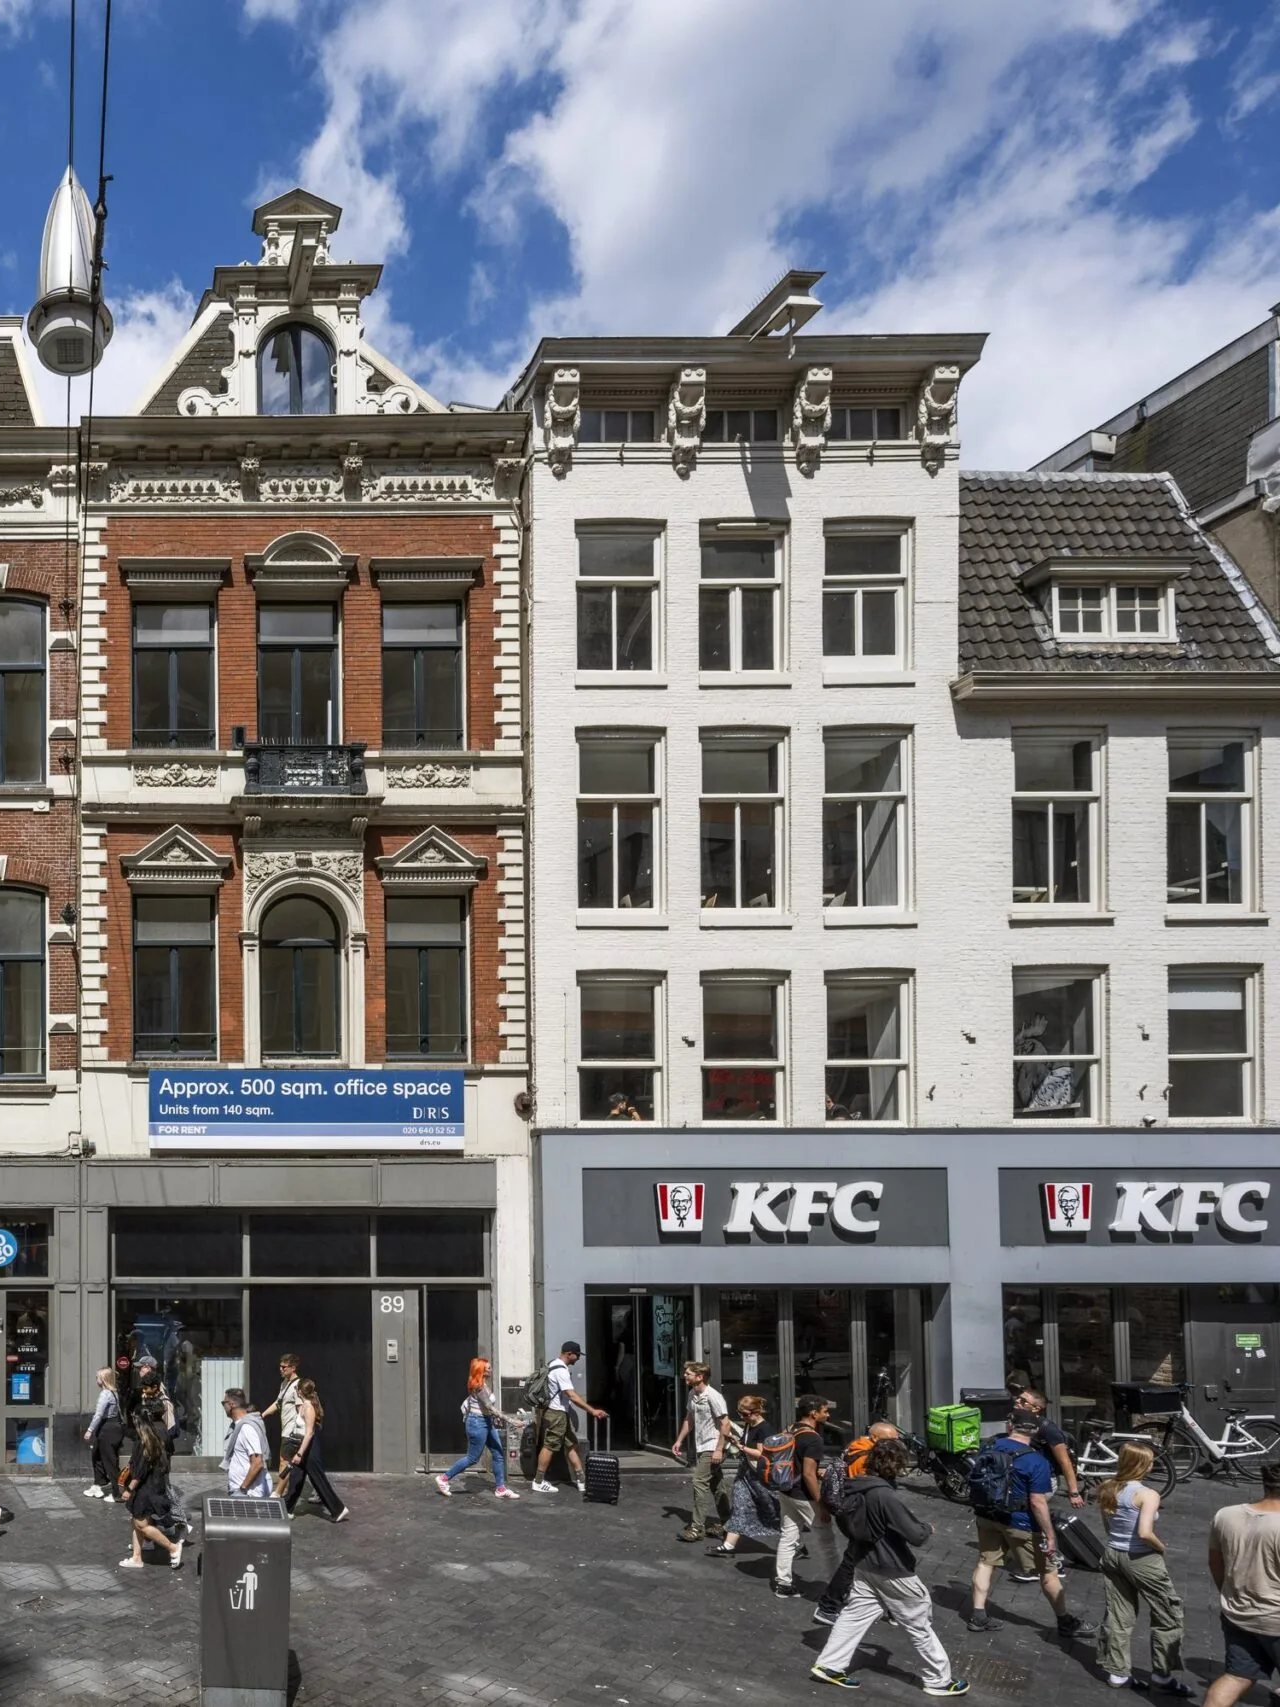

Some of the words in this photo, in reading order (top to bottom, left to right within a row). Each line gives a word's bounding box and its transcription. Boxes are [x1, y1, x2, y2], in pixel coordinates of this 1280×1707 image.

[159, 1078, 234, 1099] Approx.
[240, 1079, 276, 1096] 500
[280, 1081, 328, 1099] sqm.
[334, 1079, 388, 1096] office
[392, 1081, 452, 1099] space
[159, 1104, 190, 1115] Units
[192, 1104, 220, 1115] from
[222, 1104, 242, 1115] 140
[245, 1106, 274, 1118] sqm.
[158, 1125, 179, 1135] FOR
[180, 1125, 208, 1135] RENT
[402, 1126, 417, 1134] 020
[418, 1126, 434, 1134] 640
[434, 1126, 445, 1134] 52
[446, 1126, 456, 1134] 52
[419, 1138, 441, 1146] drs.eu
[723, 1181, 883, 1233] KFC
[1108, 1181, 1270, 1232] KFC
[380, 1296, 405, 1313] 89
[508, 1325, 522, 1335] 89
